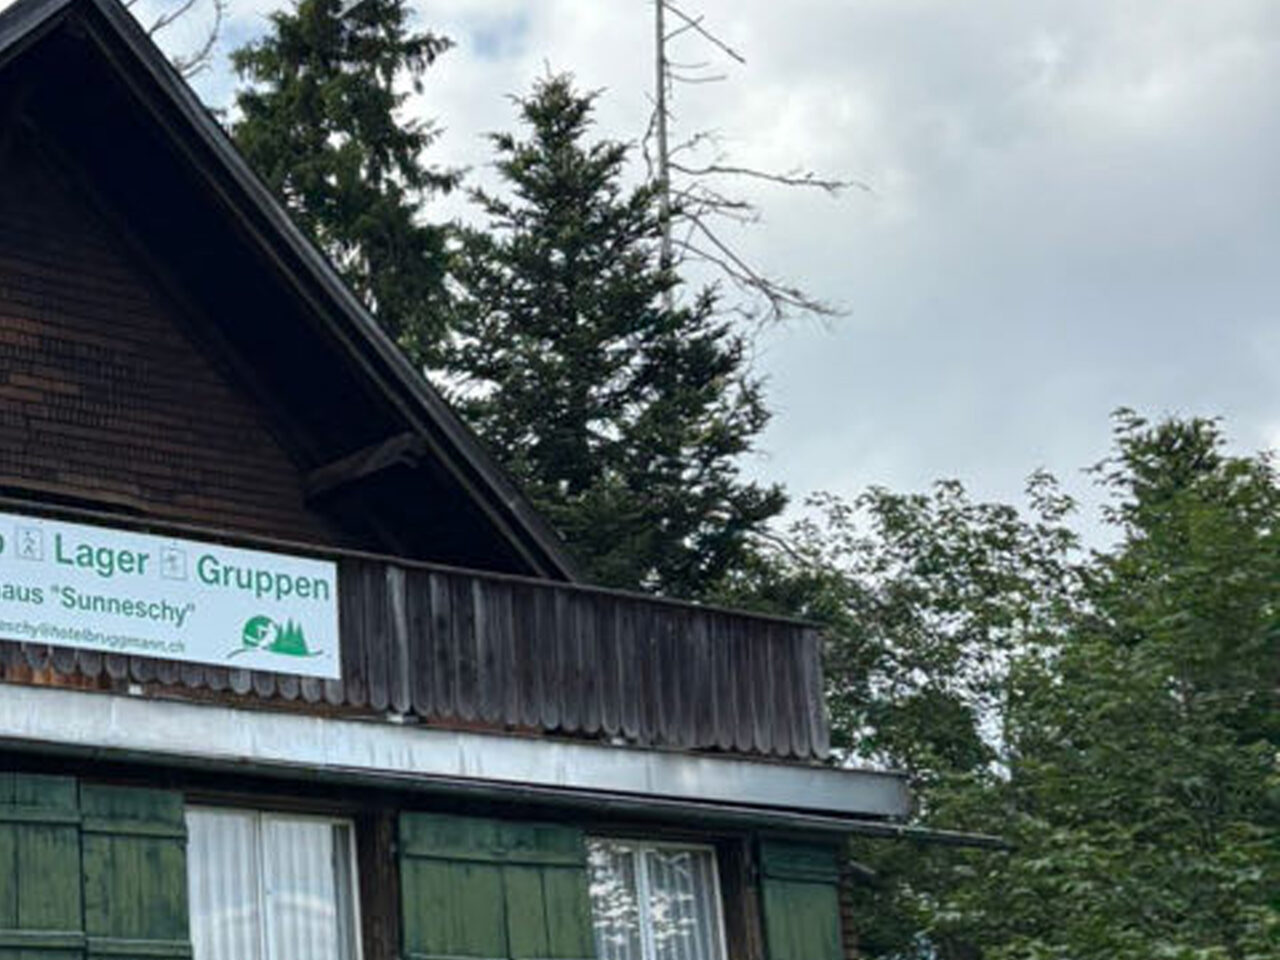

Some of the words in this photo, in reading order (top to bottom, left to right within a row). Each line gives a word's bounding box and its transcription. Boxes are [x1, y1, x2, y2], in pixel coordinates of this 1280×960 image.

[54, 534, 150, 577] Lager
[198, 555, 330, 600] Gruppen
[51, 585, 195, 627] "Sunneschy"
